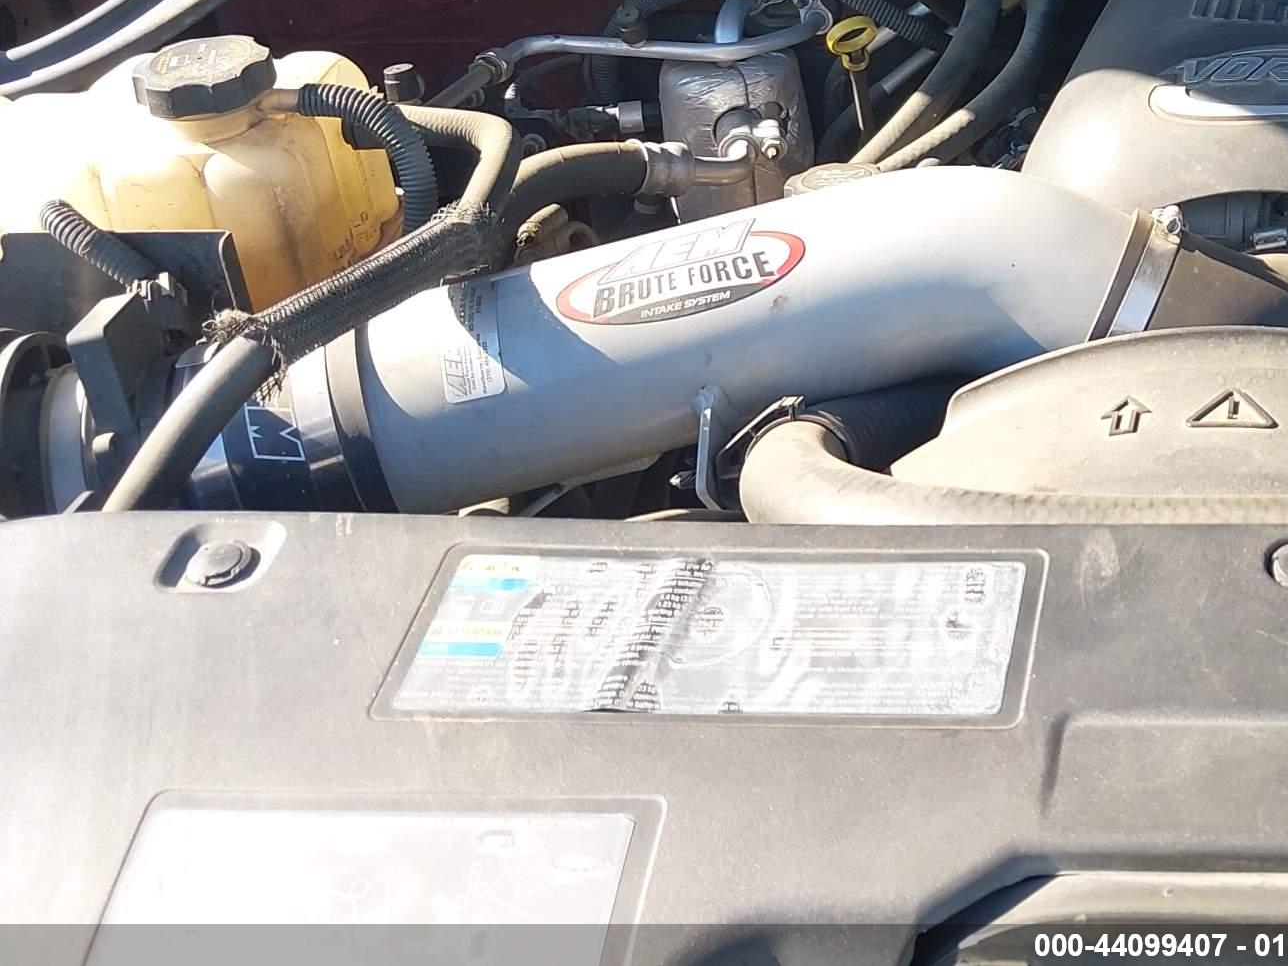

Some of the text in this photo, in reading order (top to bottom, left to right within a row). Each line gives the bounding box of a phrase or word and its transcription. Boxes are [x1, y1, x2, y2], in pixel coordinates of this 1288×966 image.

[593, 251, 776, 318] BRUTE FORCE
[598, 218, 757, 285] AEM
[640, 290, 731, 319] INTAKE SYSTEM
